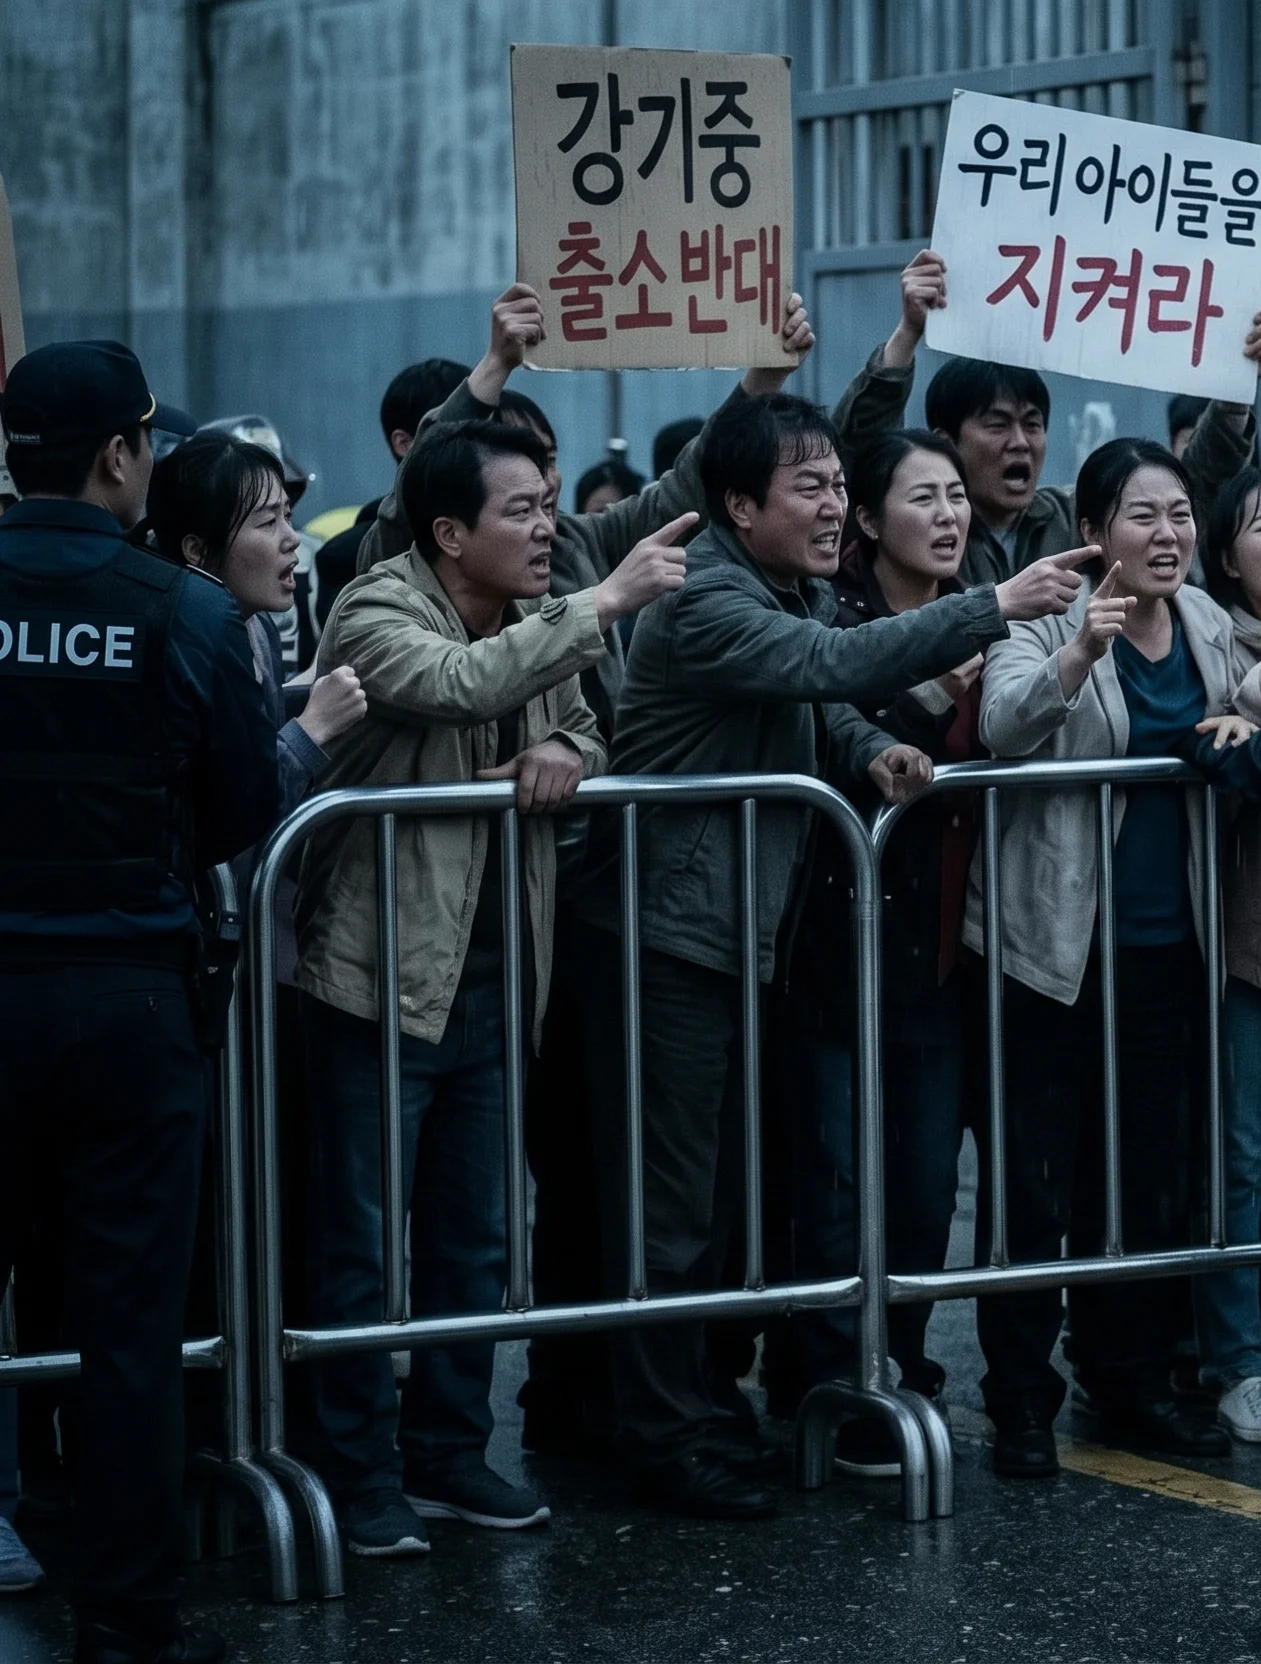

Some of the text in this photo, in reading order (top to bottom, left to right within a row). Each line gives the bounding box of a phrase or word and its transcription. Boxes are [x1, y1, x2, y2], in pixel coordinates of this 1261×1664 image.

[555, 72, 762, 209] 강기중
[957, 123, 1067, 217] 우리
[985, 234, 1224, 368] 지켜라
